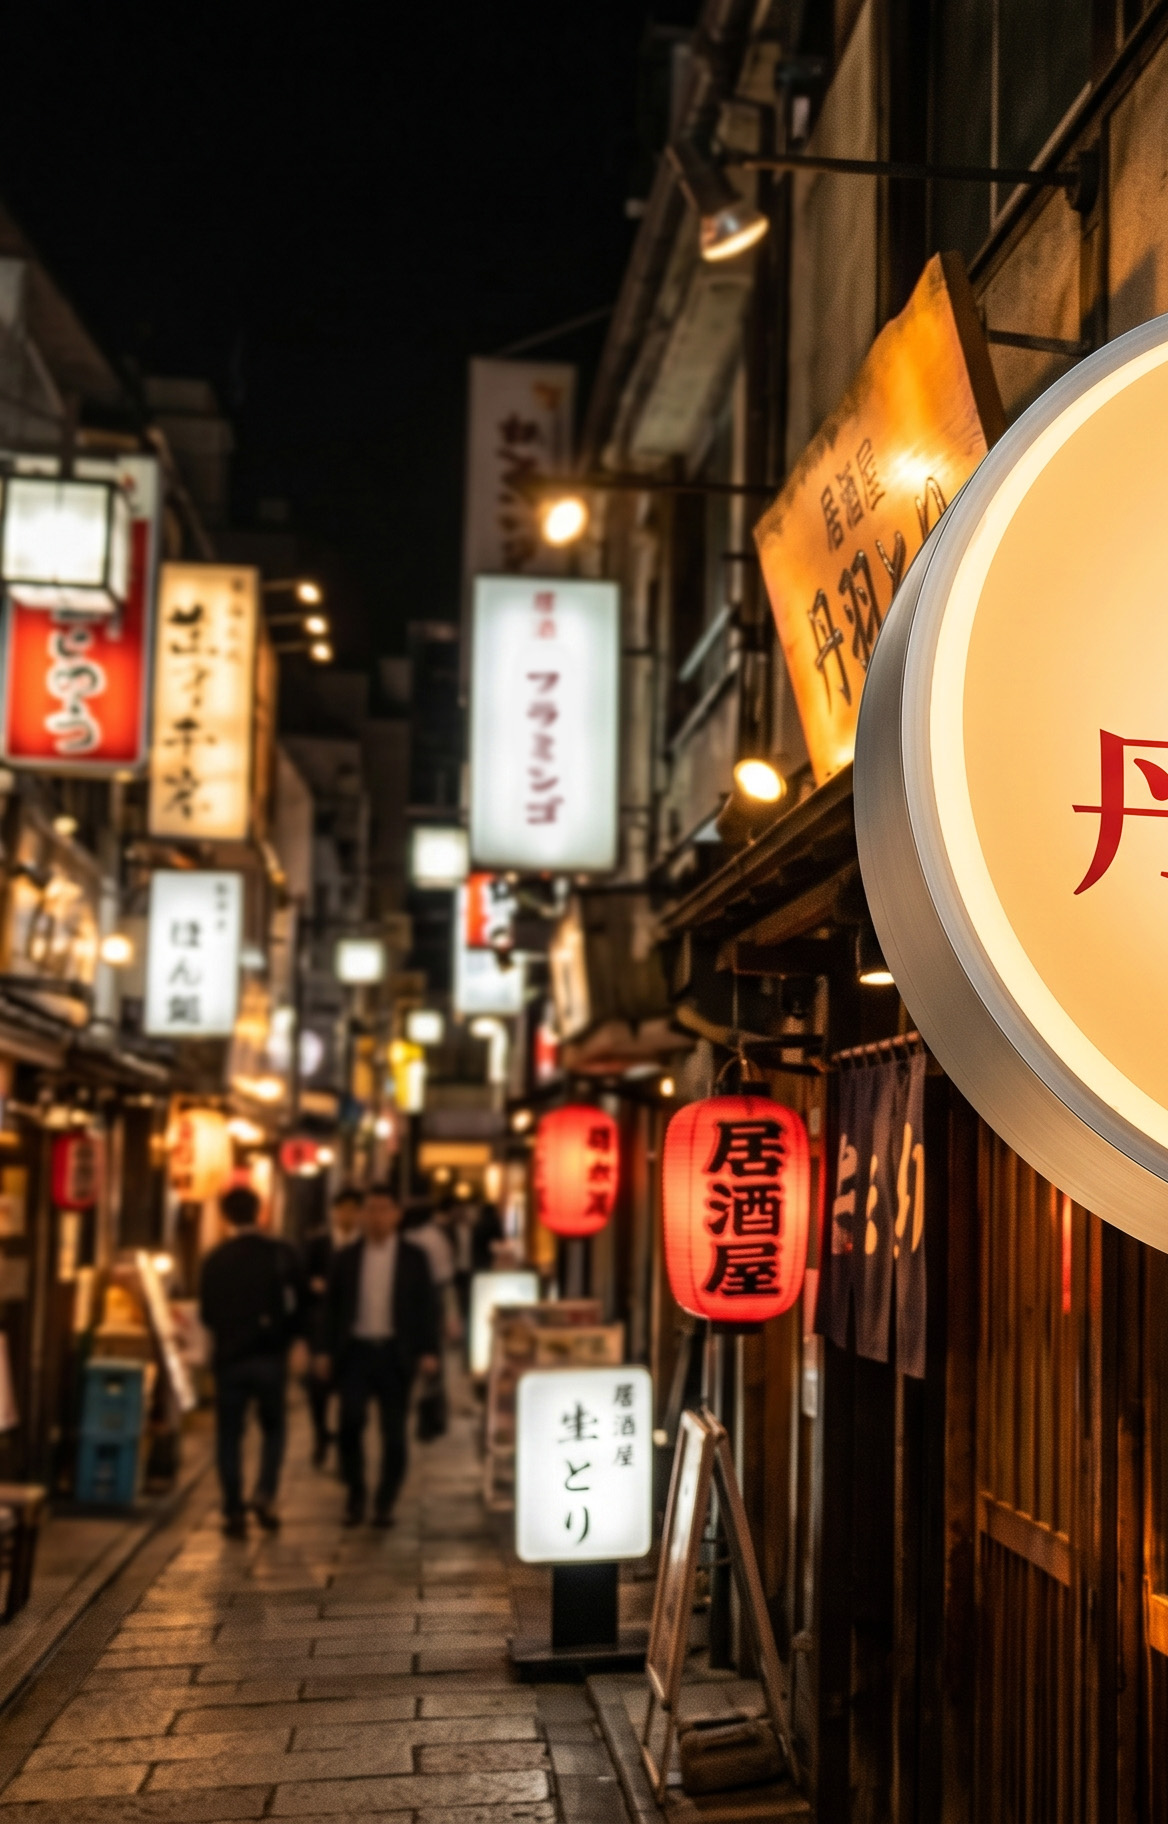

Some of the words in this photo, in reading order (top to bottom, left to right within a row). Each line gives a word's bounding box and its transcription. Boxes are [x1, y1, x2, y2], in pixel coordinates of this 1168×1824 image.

[821, 437, 886, 553] 居酒屋
[525, 671, 565, 826] フラミンゴ
[705, 1118, 788, 1298] 居酒屋
[613, 1382, 636, 1467] 居酒屋
